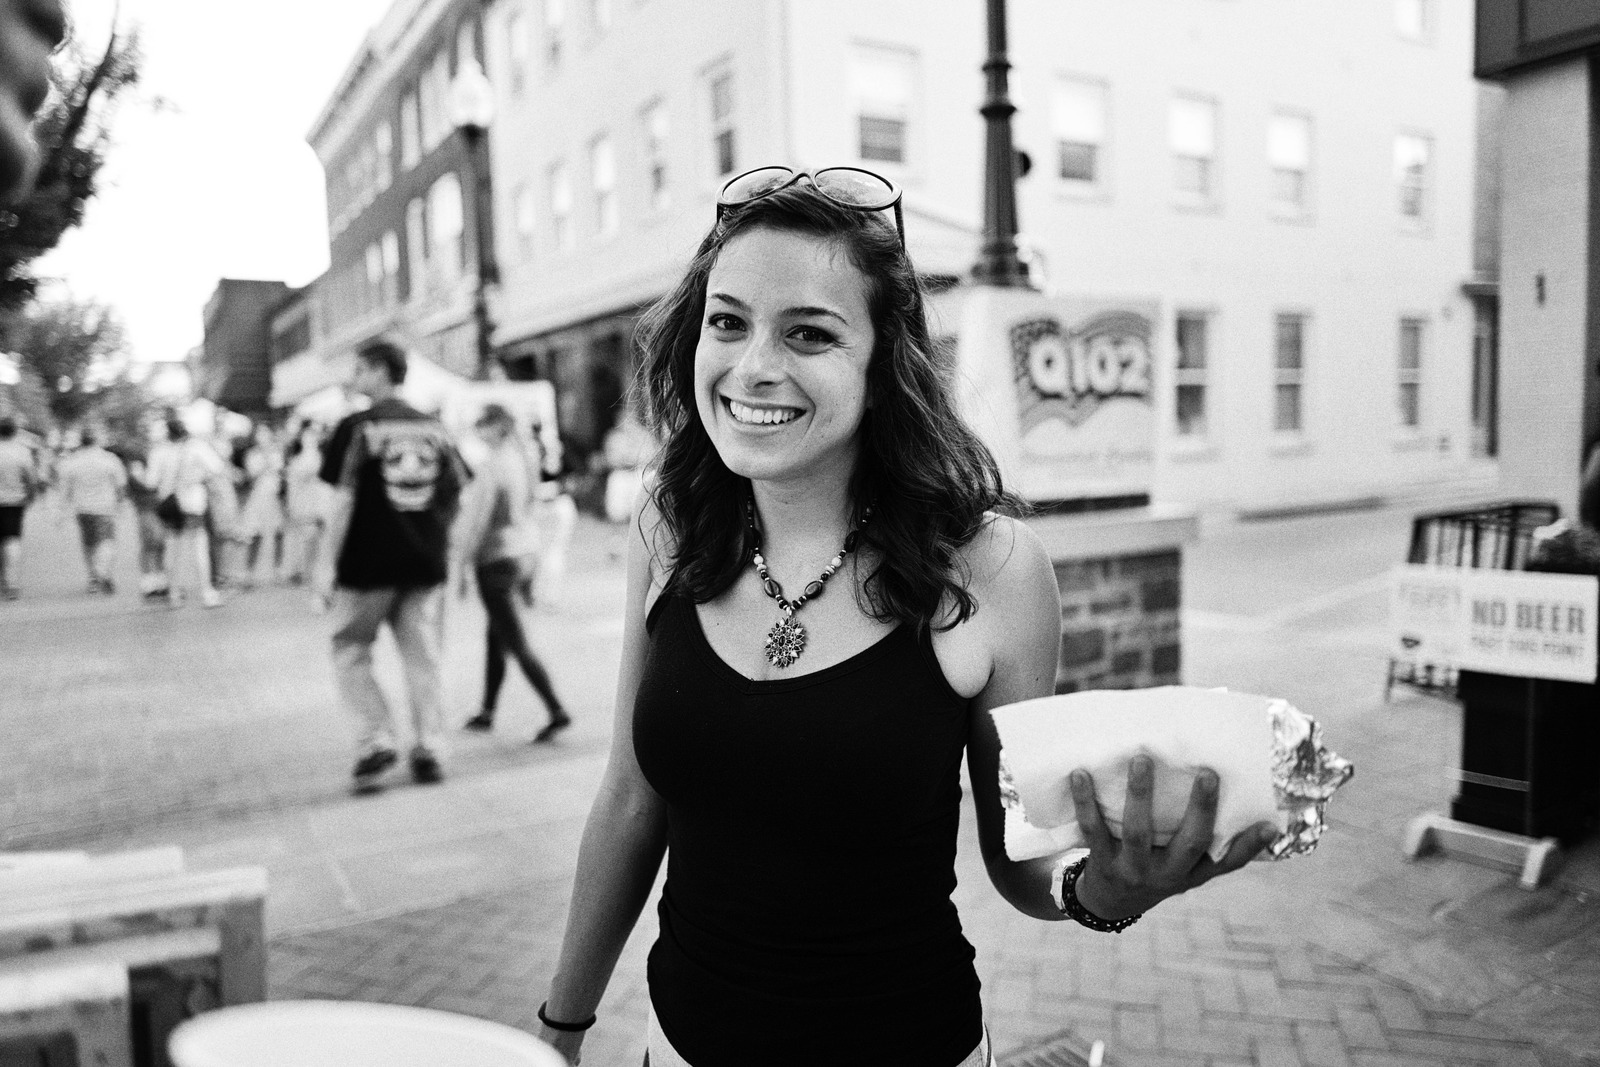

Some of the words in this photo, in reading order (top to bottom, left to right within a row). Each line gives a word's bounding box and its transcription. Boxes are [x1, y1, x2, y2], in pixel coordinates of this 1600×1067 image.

[1029, 335, 1151, 398] Q102
[1472, 600, 1506, 627] NO
[1516, 602, 1585, 634] BEER
